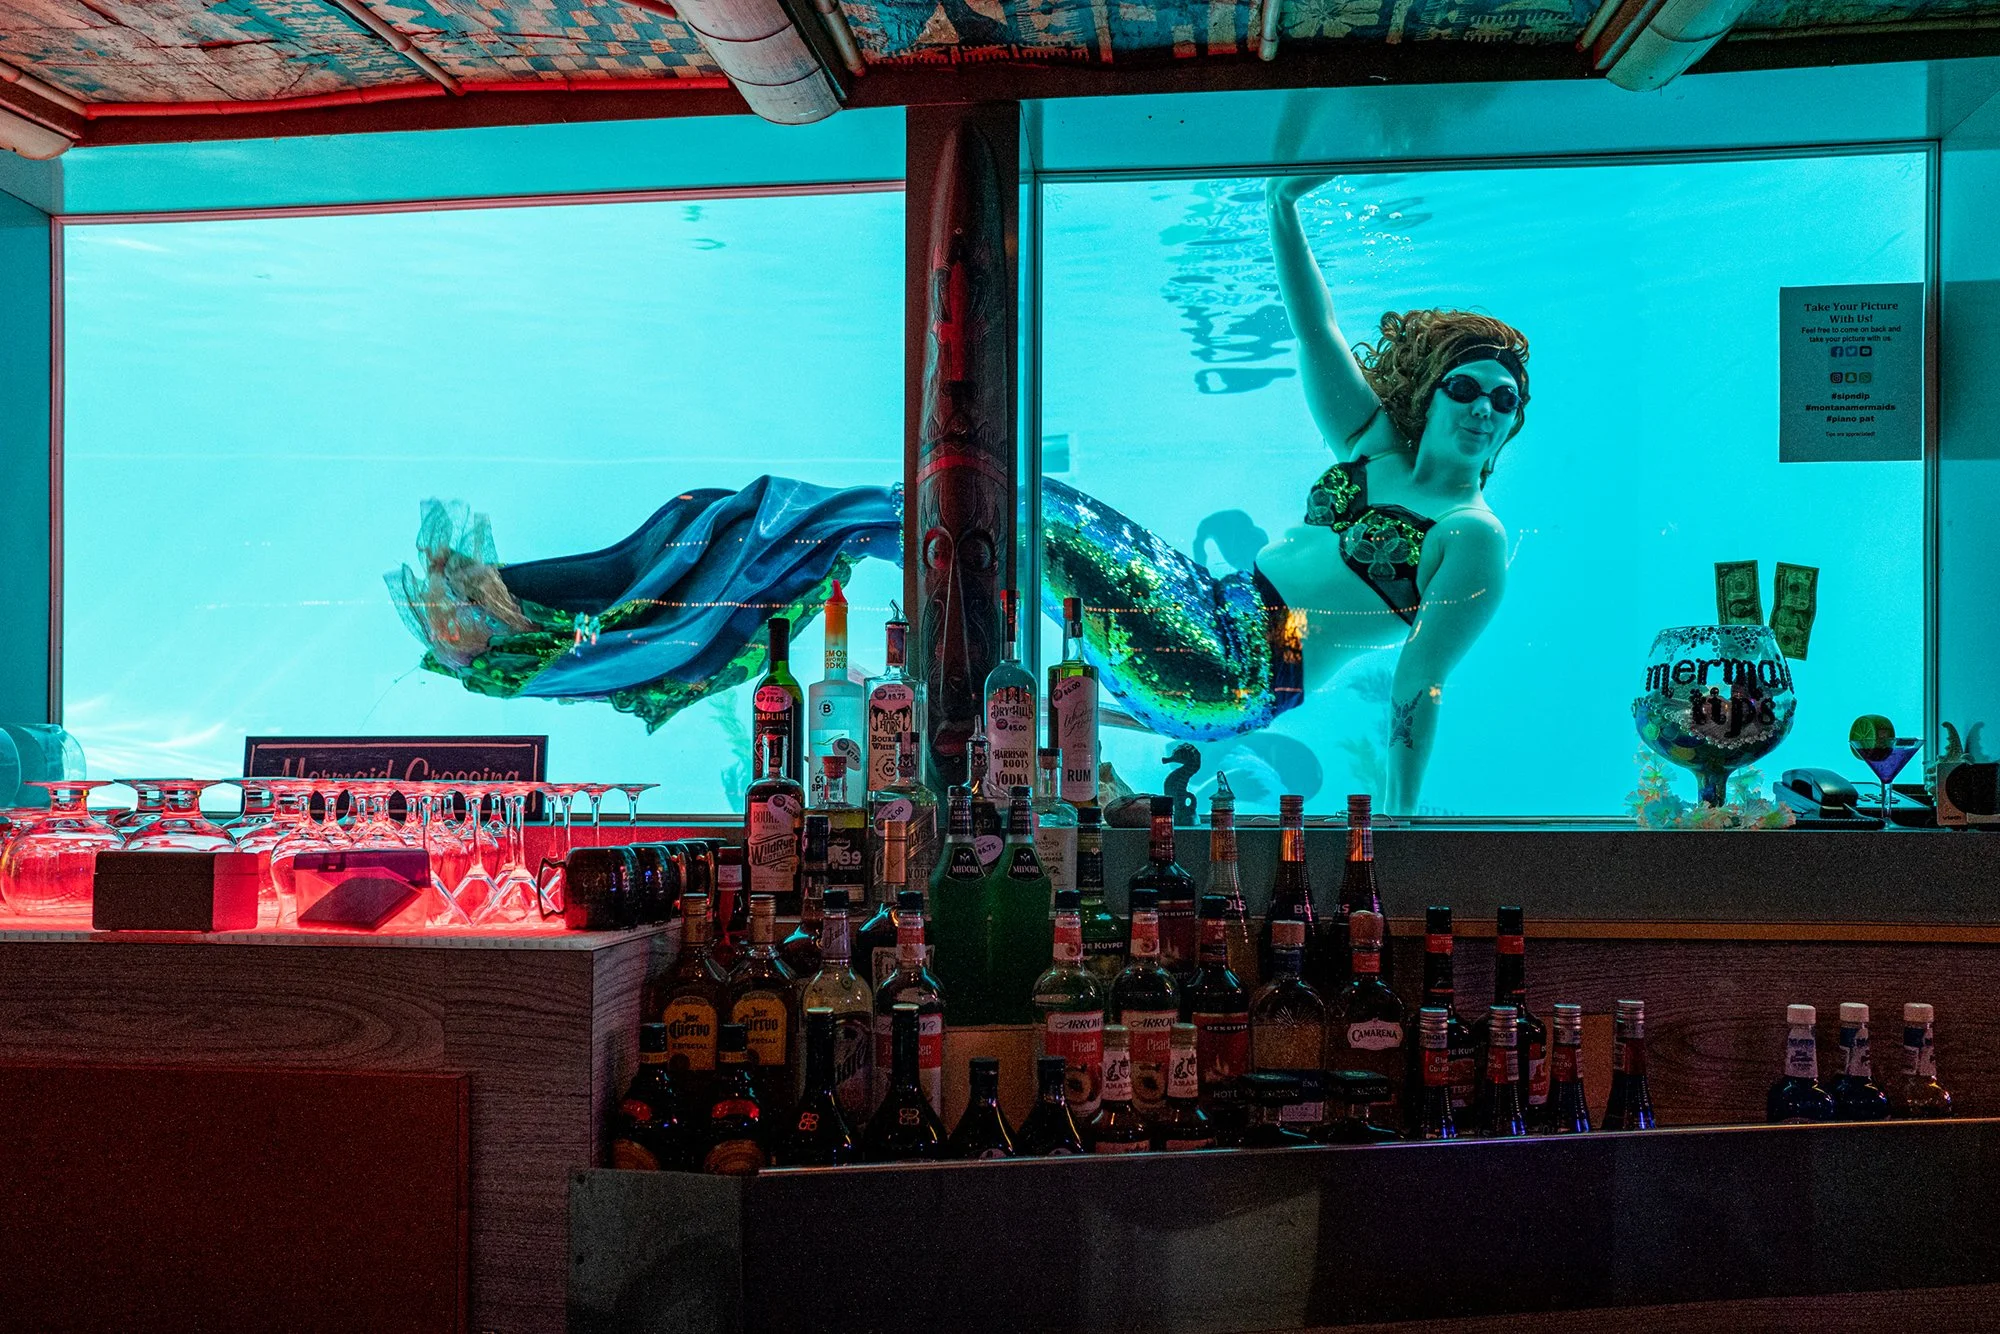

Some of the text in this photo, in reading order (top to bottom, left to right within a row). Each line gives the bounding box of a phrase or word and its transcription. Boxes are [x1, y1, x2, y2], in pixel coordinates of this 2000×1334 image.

[1804, 302, 1898, 312] Take Your Picture
[1830, 314, 1873, 323] With Us!
[1842, 335, 1865, 343] picture
[1831, 392, 1870, 401] #sipndip
[1805, 403, 1896, 411] #montanamermaids
[1826, 415, 1875, 423] #piano pat
[823, 704, 831, 713] B
[1690, 687, 1776, 738] tips
[755, 713, 790, 721] TRAPLINE
[882, 710, 900, 720] BIG
[871, 742, 896, 750] WHIS
[995, 770, 1029, 786] VODKA
[1067, 769, 1091, 782] RUM
[907, 868, 930, 879] VOD
[951, 866, 979, 874] MIDORI
[1012, 866, 1039, 874] MIDORI
[1226, 899, 1247, 911] OLS
[1293, 903, 1317, 914] BOL
[1056, 1018, 1103, 1030] ARROW
[669, 1021, 710, 1039] Cuervo
[1352, 1029, 1398, 1042] CAMARENA
